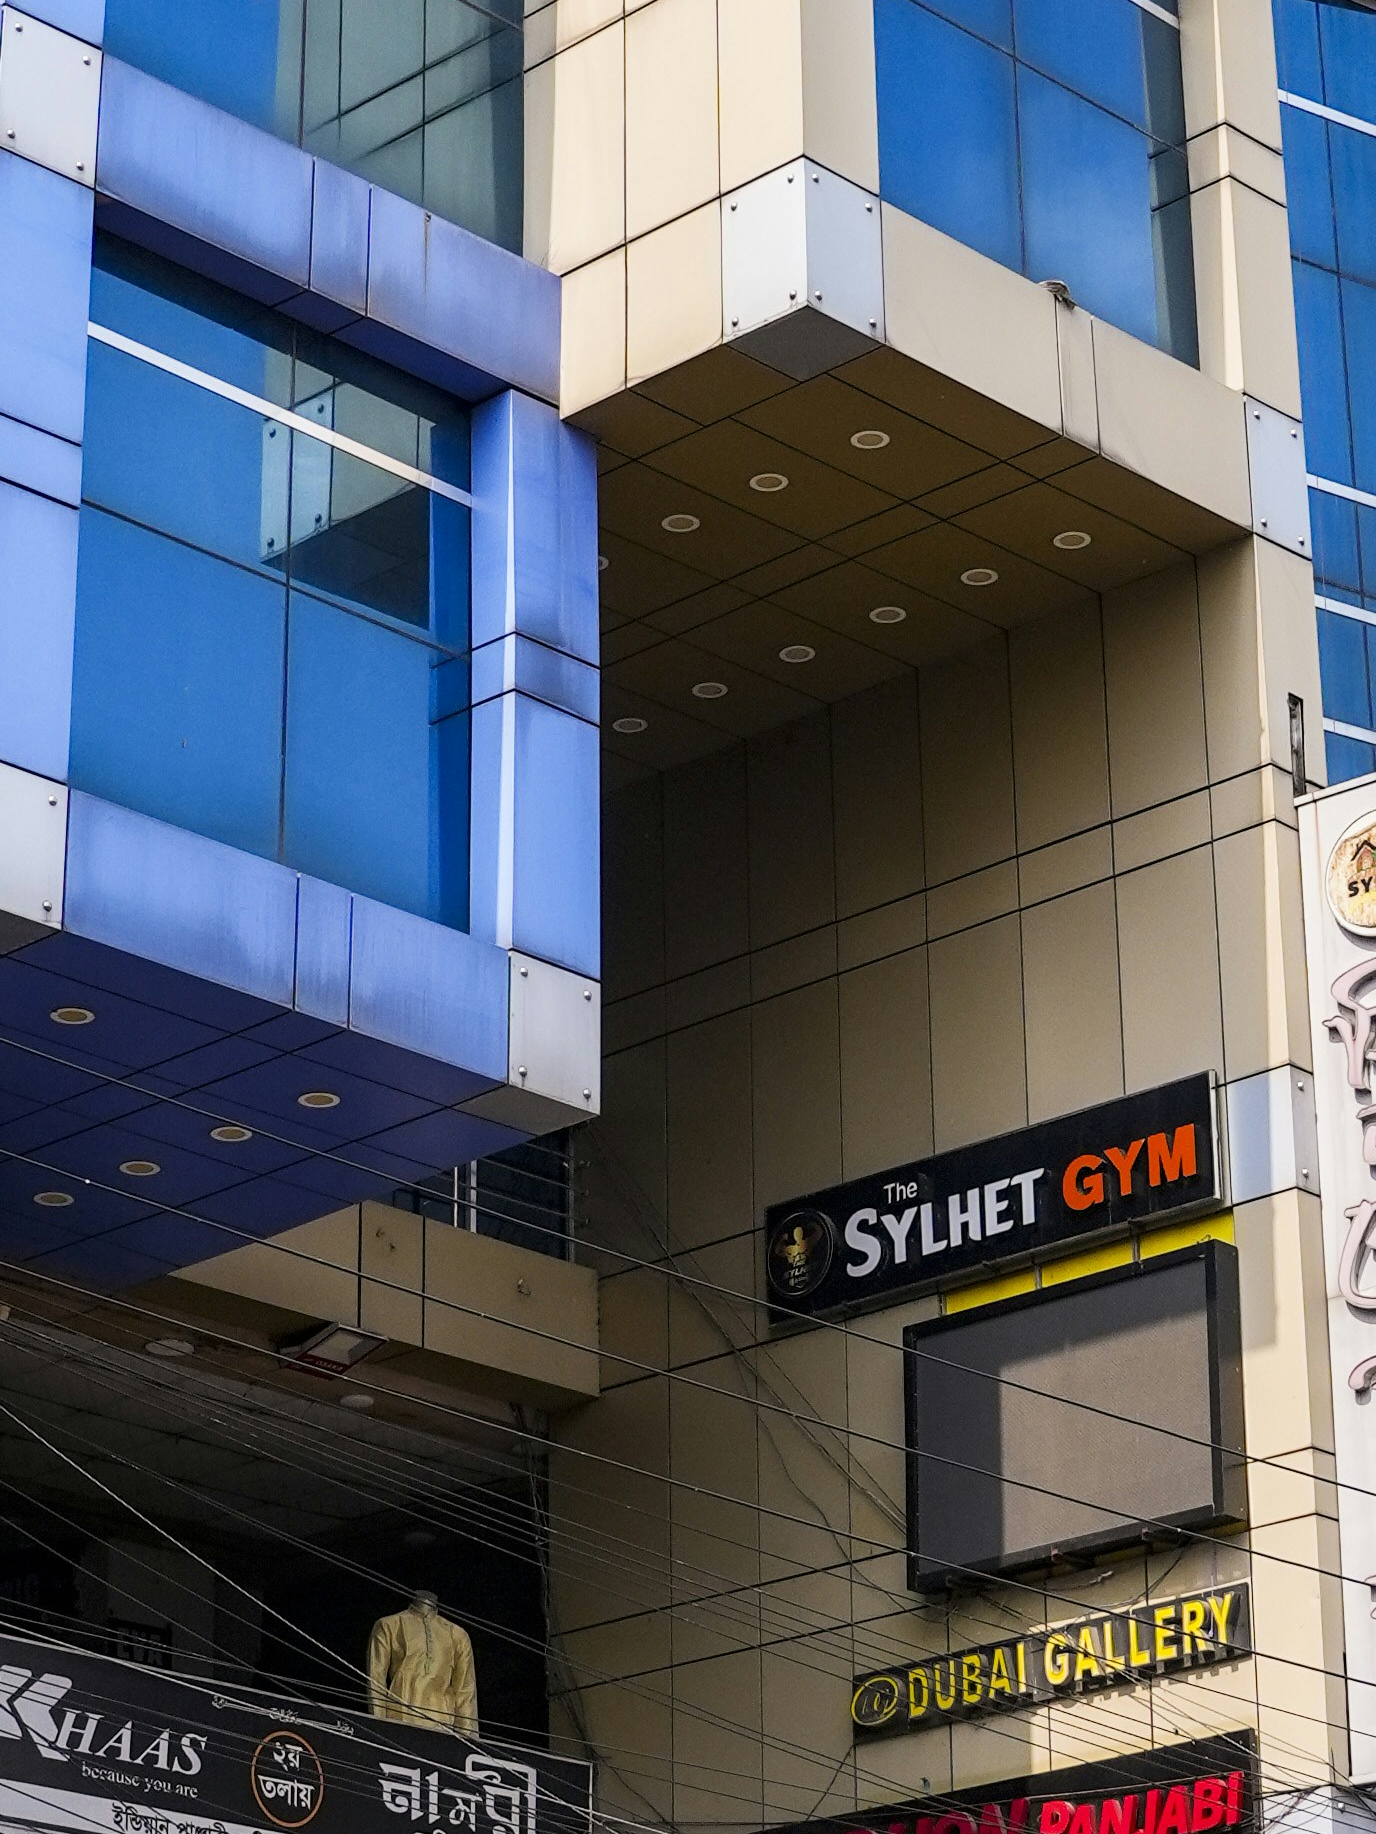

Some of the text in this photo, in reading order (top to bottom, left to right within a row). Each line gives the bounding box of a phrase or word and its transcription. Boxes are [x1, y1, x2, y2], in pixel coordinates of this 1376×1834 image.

[843, 1122, 1197, 1278] SYLHET GYM
[882, 1177, 918, 1206] The
[906, 1592, 1236, 1718] DUBAI GALLERY
[81, 1760, 199, 1801] because you are
[257, 1772, 314, 1810] তলায়
